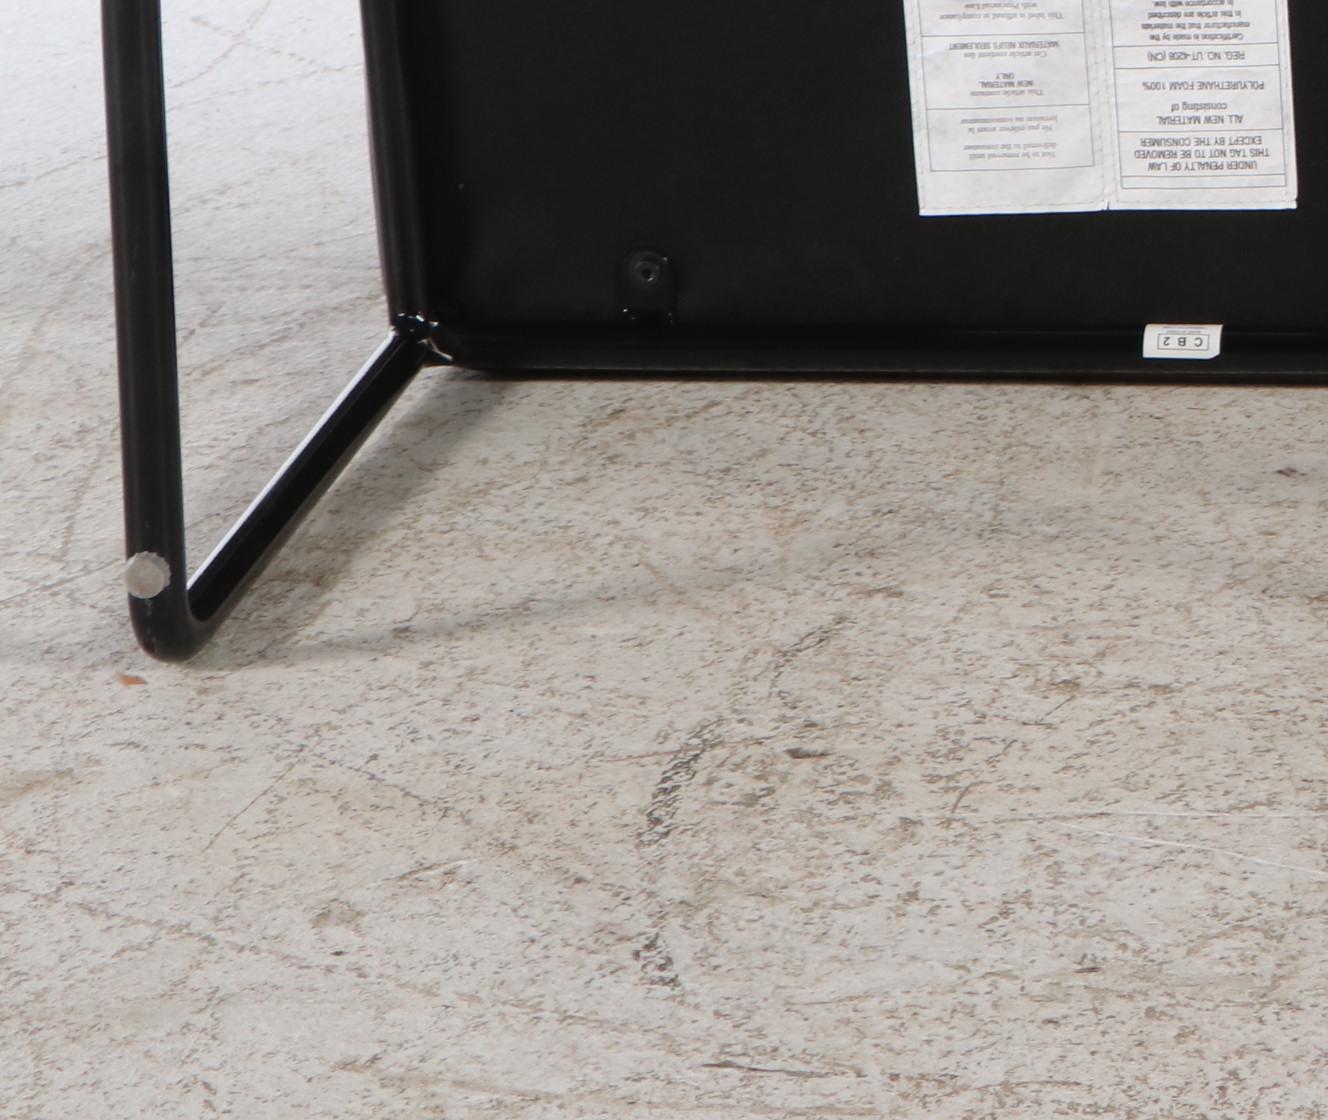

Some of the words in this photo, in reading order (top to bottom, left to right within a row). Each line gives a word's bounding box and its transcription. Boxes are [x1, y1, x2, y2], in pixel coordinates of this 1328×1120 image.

[1148, 52, 1167, 61] (CN)
[1142, 81, 1166, 90] 100%
[1169, 81, 1195, 90] FOAM
[1197, 81, 1264, 89] POLYURETHANE
[1171, 104, 1180, 112] of
[1182, 102, 1227, 112] consisting
[1156, 115, 1202, 124] MATERIAL
[1204, 115, 1225, 124] NEW
[1229, 115, 1243, 123] ALL
[1141, 137, 1192, 146] CONSUMER
[1195, 137, 1211, 145] THE
[1214, 137, 1226, 145] BY
[1229, 136, 1261, 145] EXCEPT
[1134, 150, 1178, 159] REMOVED
[1181, 150, 1192, 158] BE
[1195, 149, 1206, 158] TO
[1210, 149, 1228, 158] NOT
[1229, 149, 1246, 157] TAG
[1250, 148, 1269, 157] THIS
[1148, 162, 1168, 171] LAW
[1171, 162, 1182, 170] OF
[1185, 161, 1225, 170] PENALTY
[1226, 161, 1257, 170] UNDER
